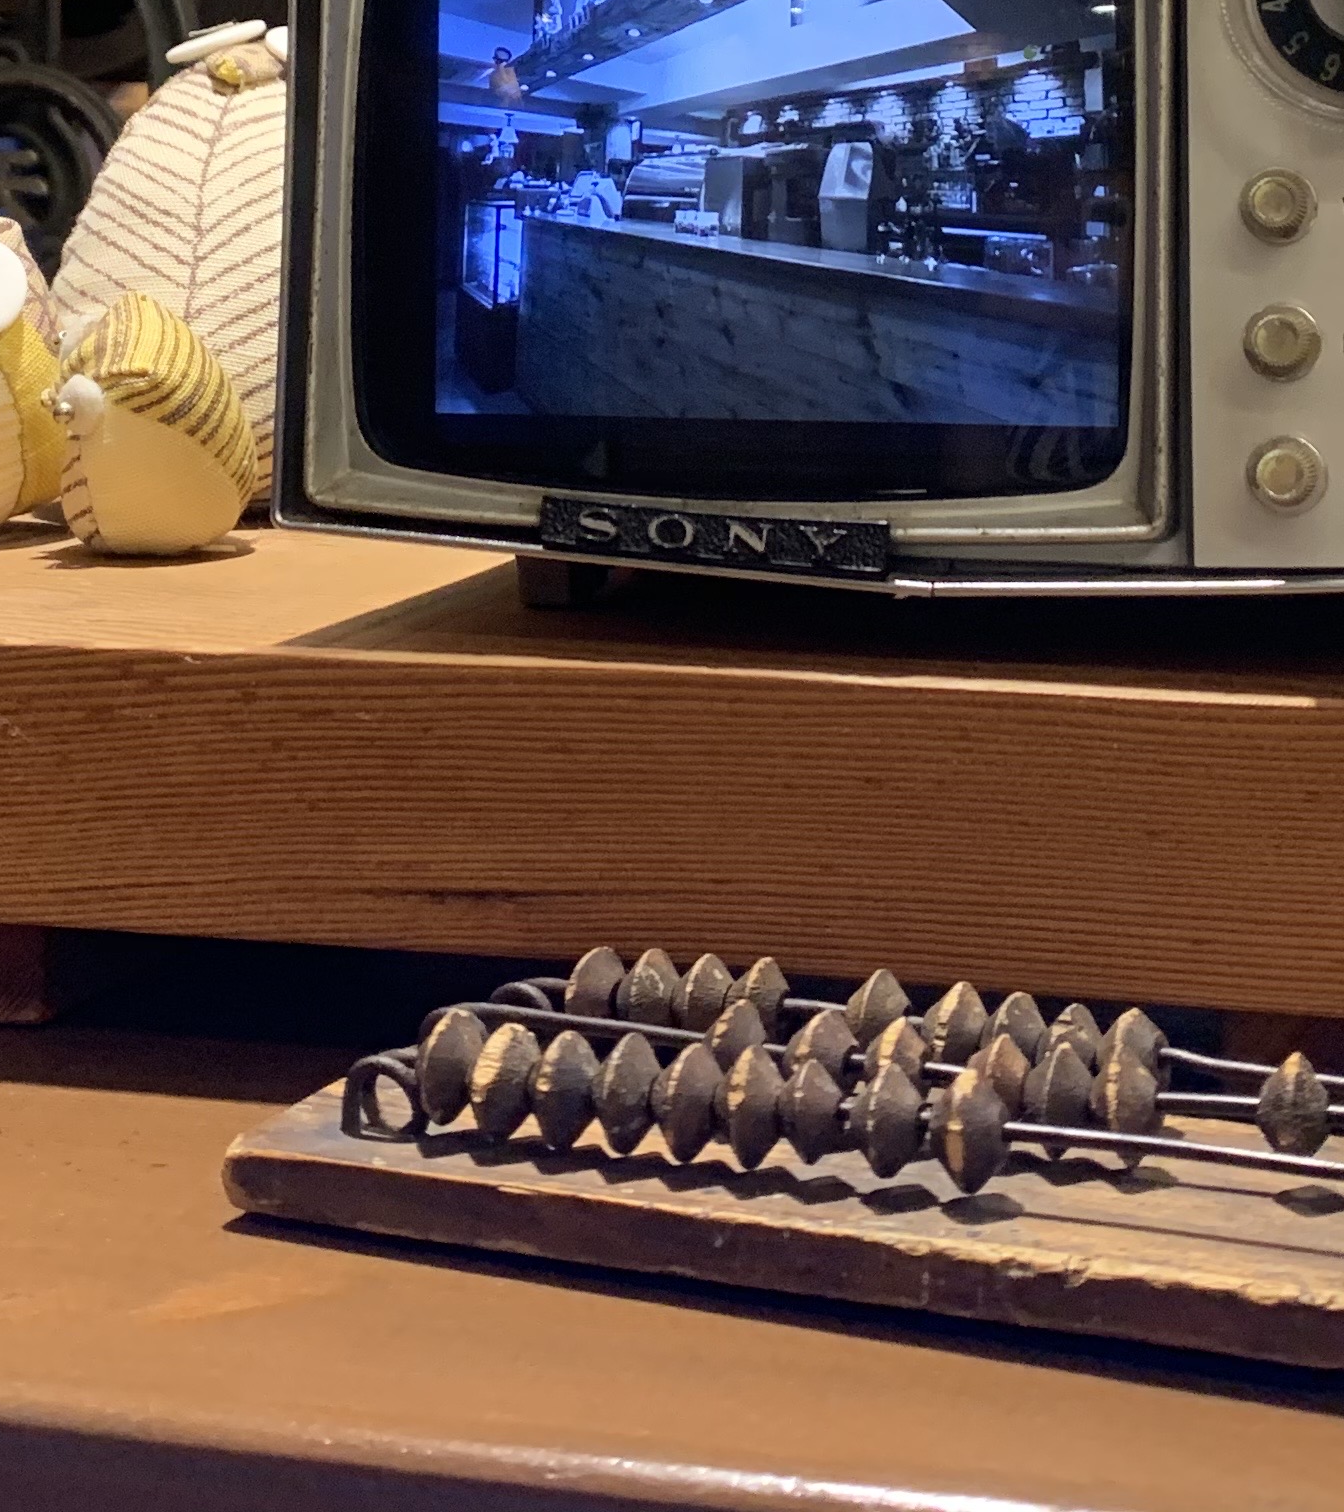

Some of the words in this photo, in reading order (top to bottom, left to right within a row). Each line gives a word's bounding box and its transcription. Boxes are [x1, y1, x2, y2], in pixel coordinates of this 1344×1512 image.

[1282, 31, 1310, 56] 5
[1320, 53, 1341, 82] 6
[576, 508, 848, 555] SONY
